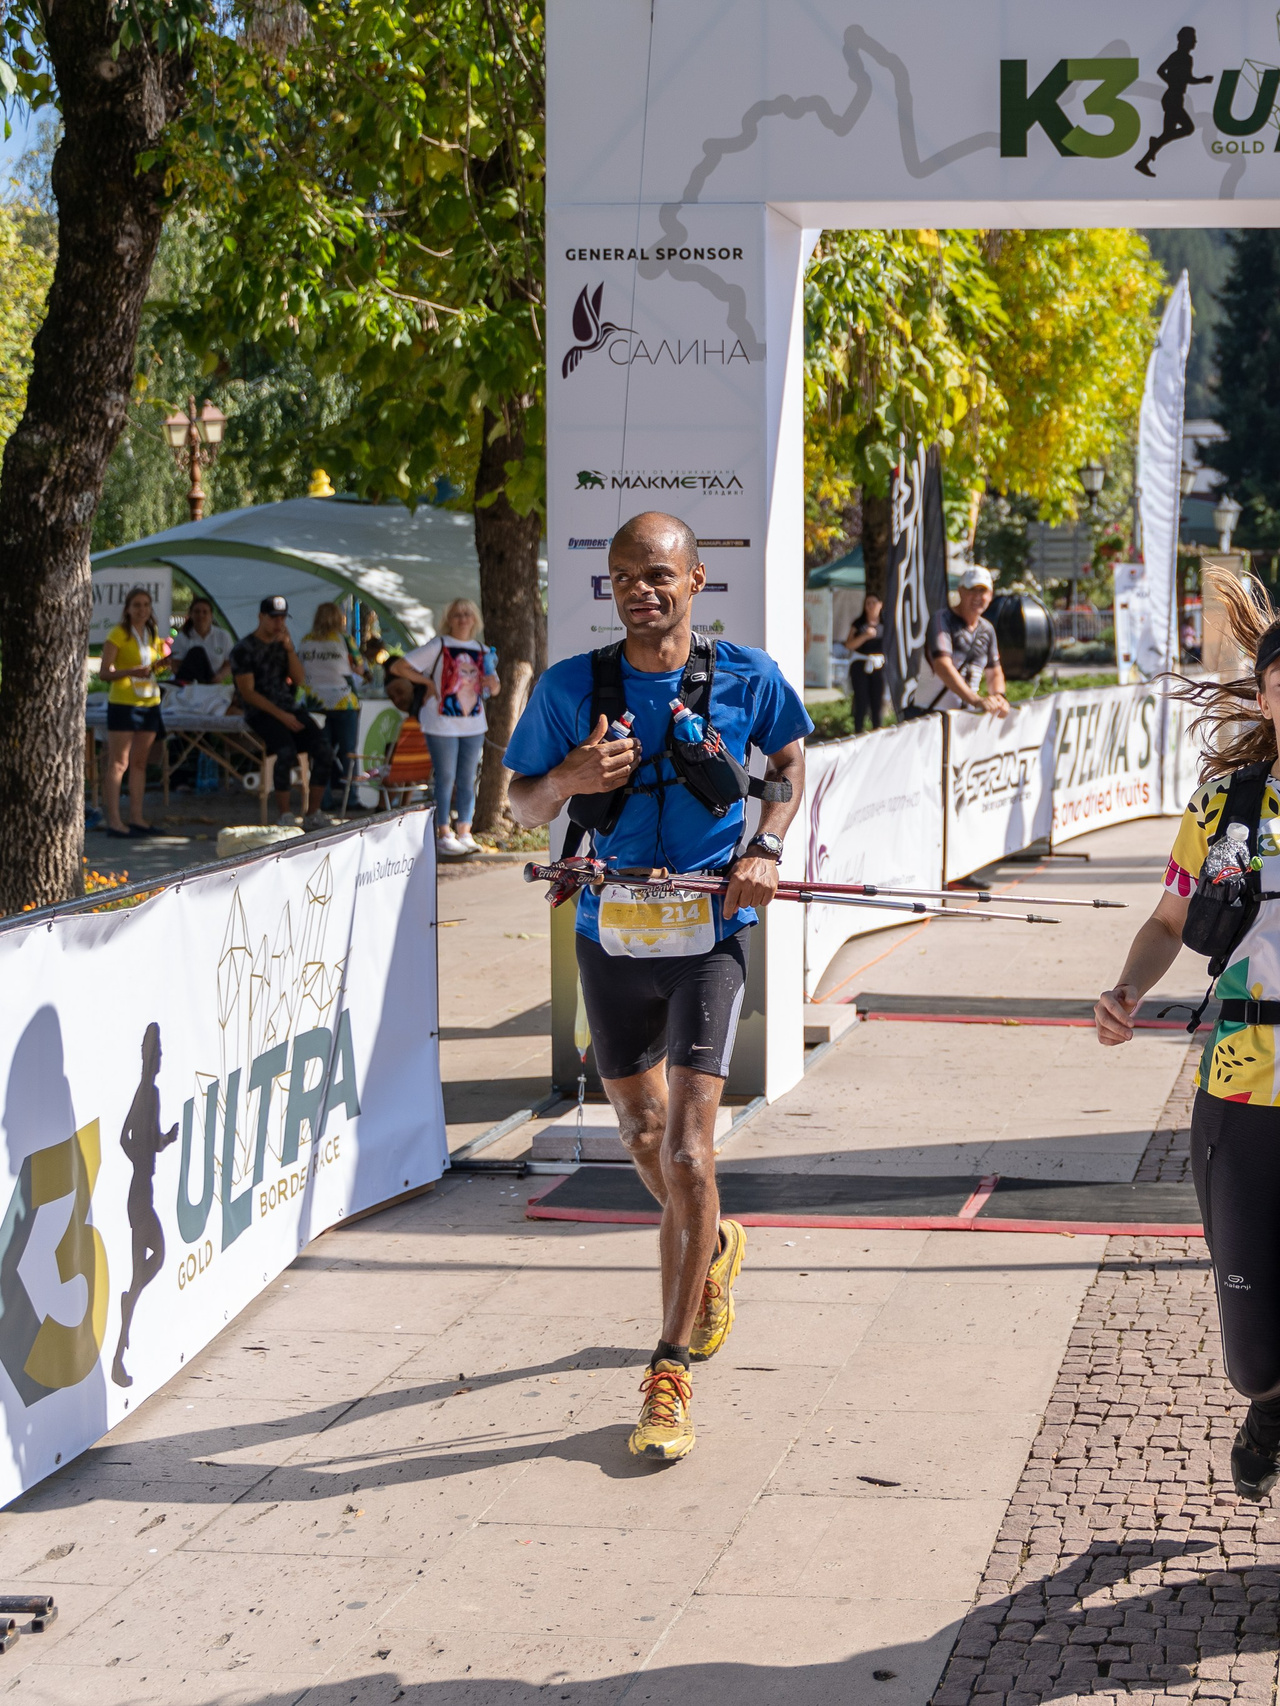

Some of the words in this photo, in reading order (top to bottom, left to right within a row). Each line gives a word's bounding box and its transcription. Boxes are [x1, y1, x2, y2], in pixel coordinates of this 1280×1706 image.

[1000, 58, 1141, 158] K3
[1211, 140, 1266, 155] GOLD
[565, 248, 650, 261] GENERAL
[656, 247, 744, 260] SPONSOR
[608, 339, 751, 366] САЛИНА
[611, 475, 744, 489] МАКМЕТАЛ
[1053, 694, 1156, 790] ETELINA'S
[661, 903, 700, 923] 214
[176, 1009, 361, 1252] ULTRA
[178, 1239, 213, 1290] GOLD
